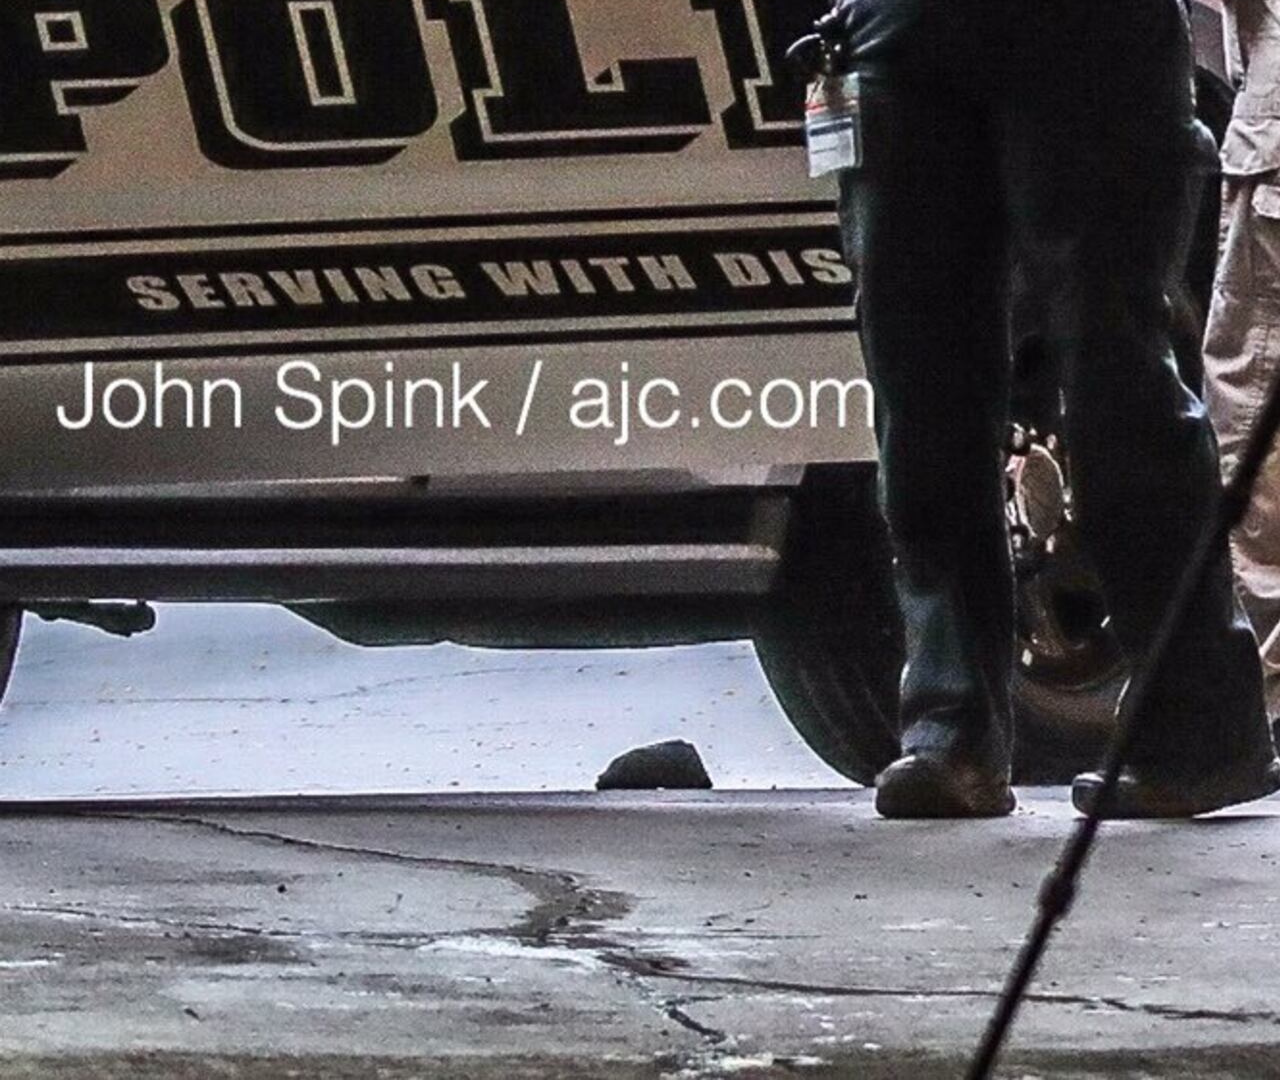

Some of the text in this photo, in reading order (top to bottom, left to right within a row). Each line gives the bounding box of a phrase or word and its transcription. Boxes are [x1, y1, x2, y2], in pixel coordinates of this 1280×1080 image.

[126, 247, 853, 311] SERVING WITH DIS
